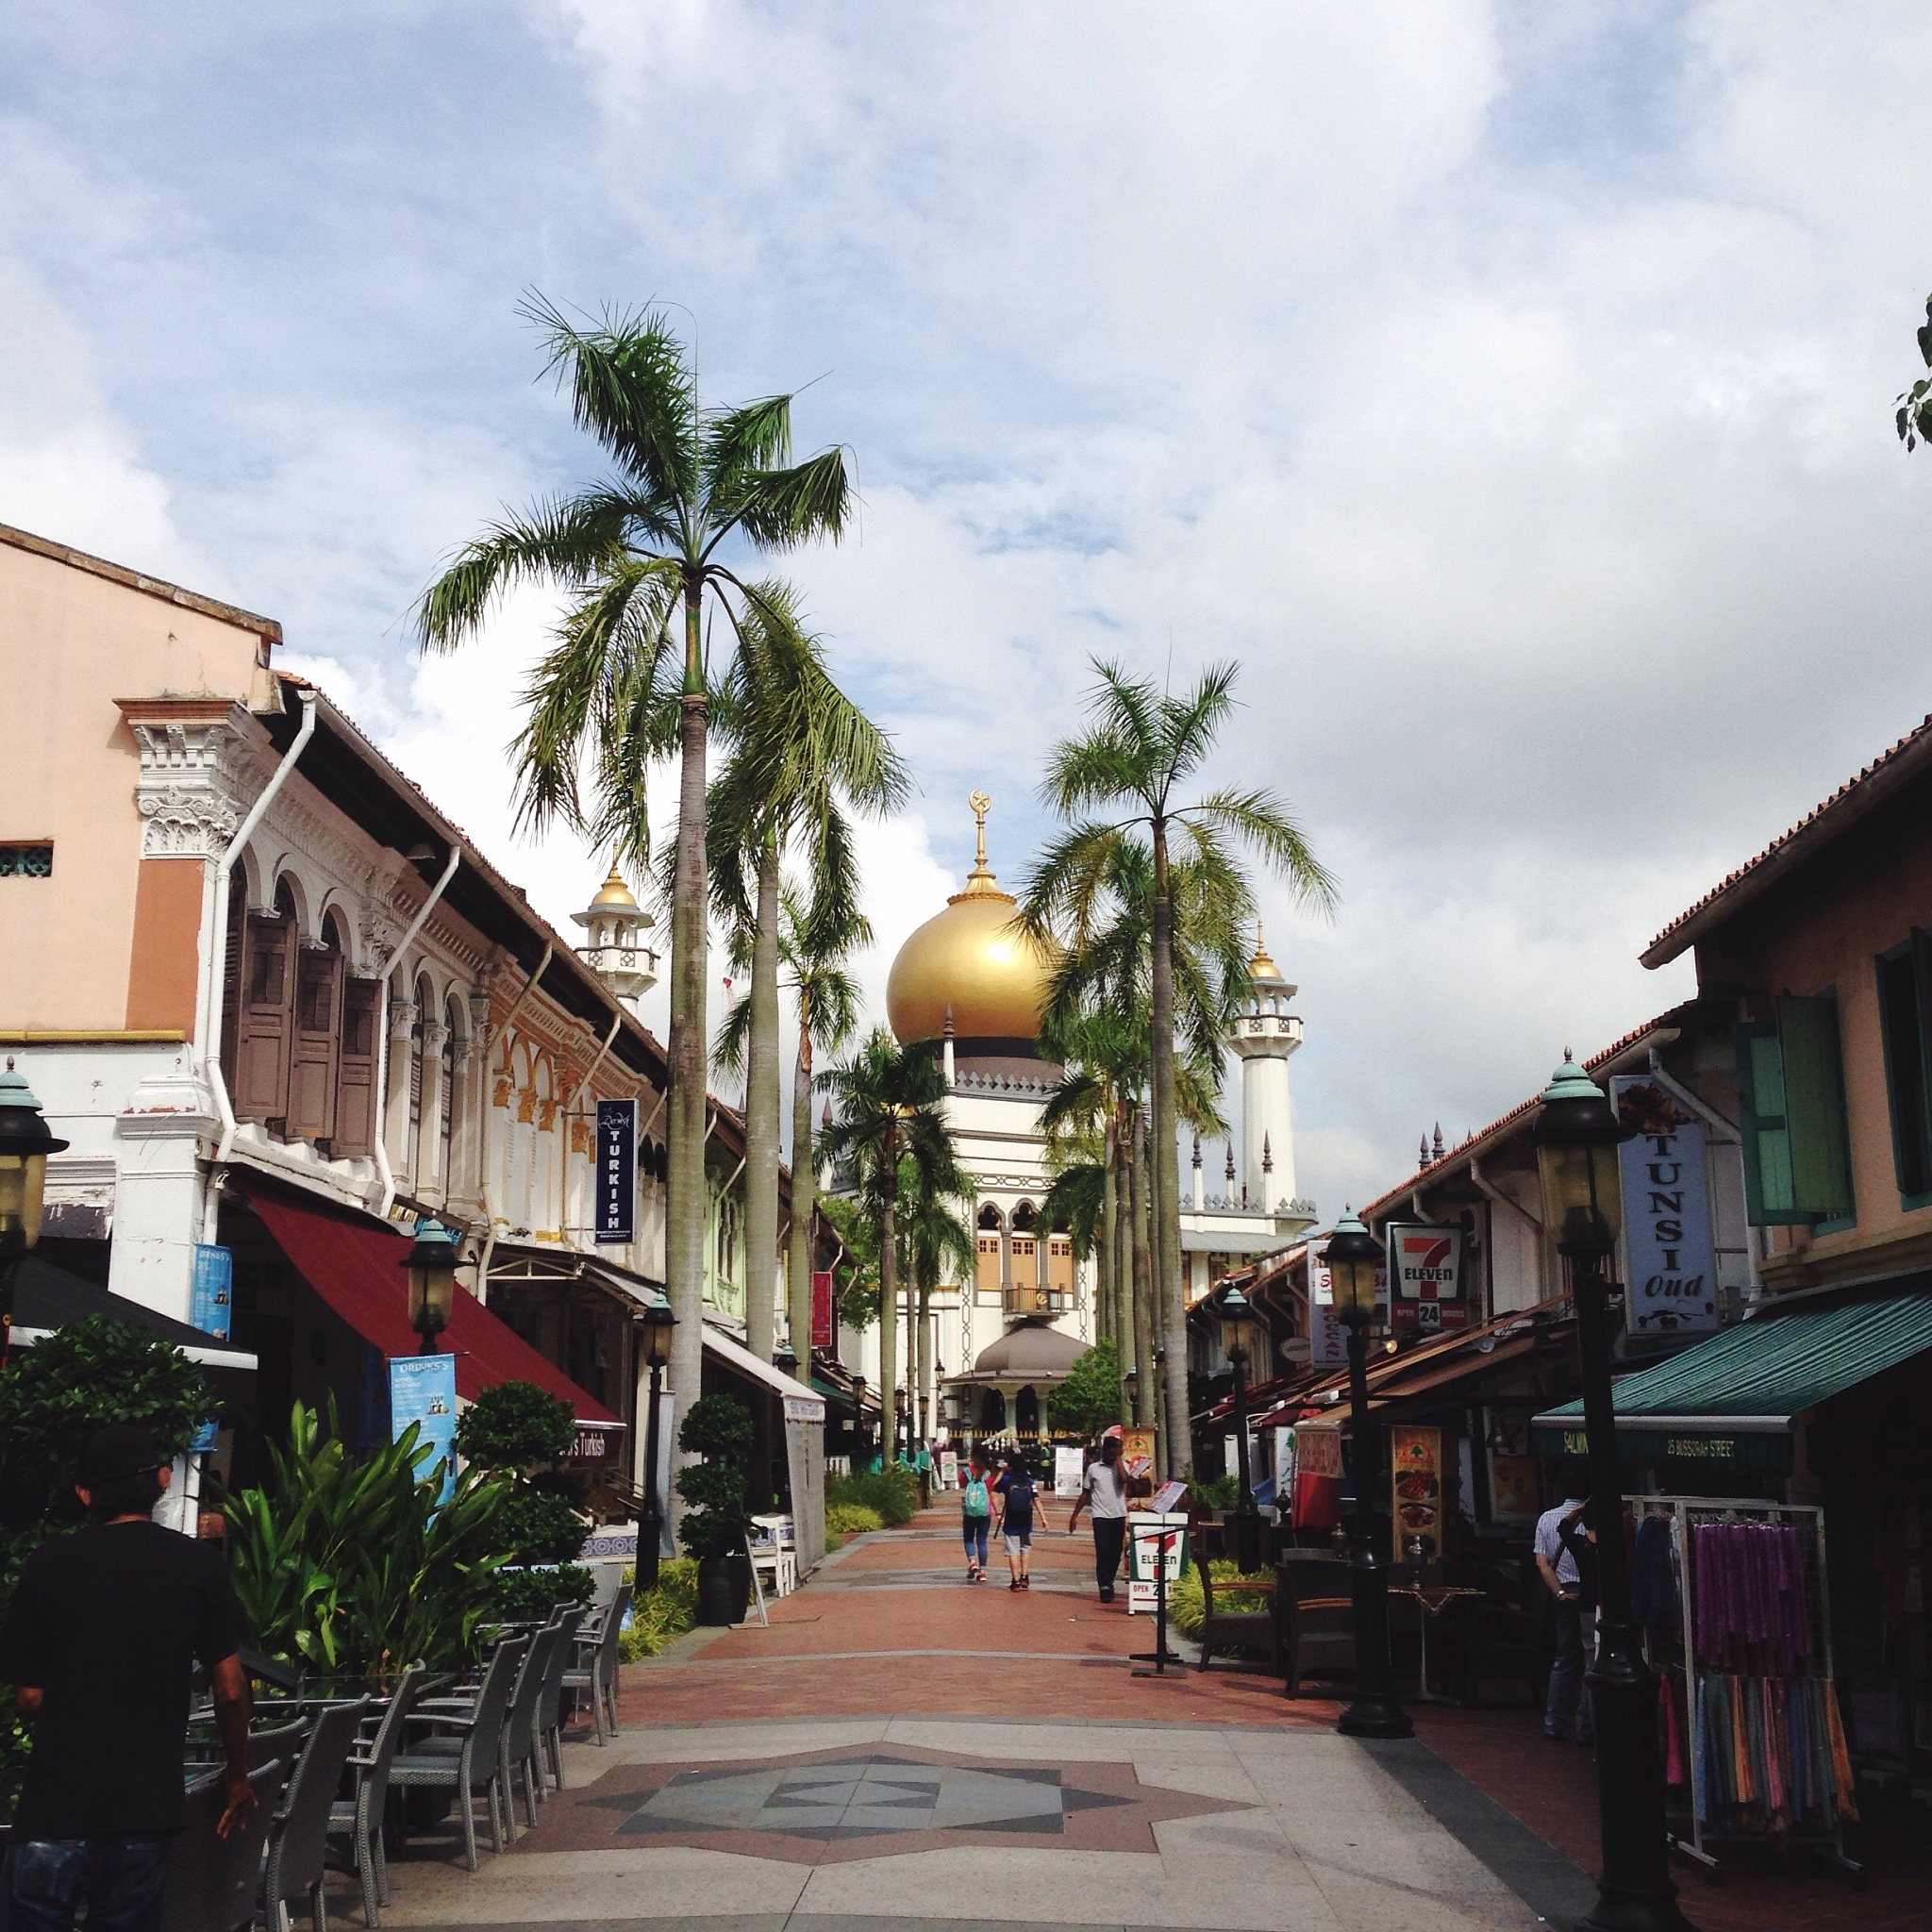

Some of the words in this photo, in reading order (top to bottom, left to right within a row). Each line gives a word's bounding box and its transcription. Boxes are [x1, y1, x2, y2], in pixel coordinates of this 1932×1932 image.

[608, 1130, 621, 1228] TURKISH
[1645, 1135, 1684, 1270] TUNSI
[1404, 1238, 1451, 1298] 7
[1645, 1274, 1704, 1297] Oud
[1396, 1308, 1414, 1317] OPEN
[1420, 1306, 1439, 1323] 24
[580, 1432, 605, 1457] Turkish
[1667, 1439, 1675, 1455] 25
[1675, 1440, 1709, 1457] BUSSORAH
[1709, 1440, 1735, 1457] STREET
[1141, 1556, 1176, 1564] ELEEn
